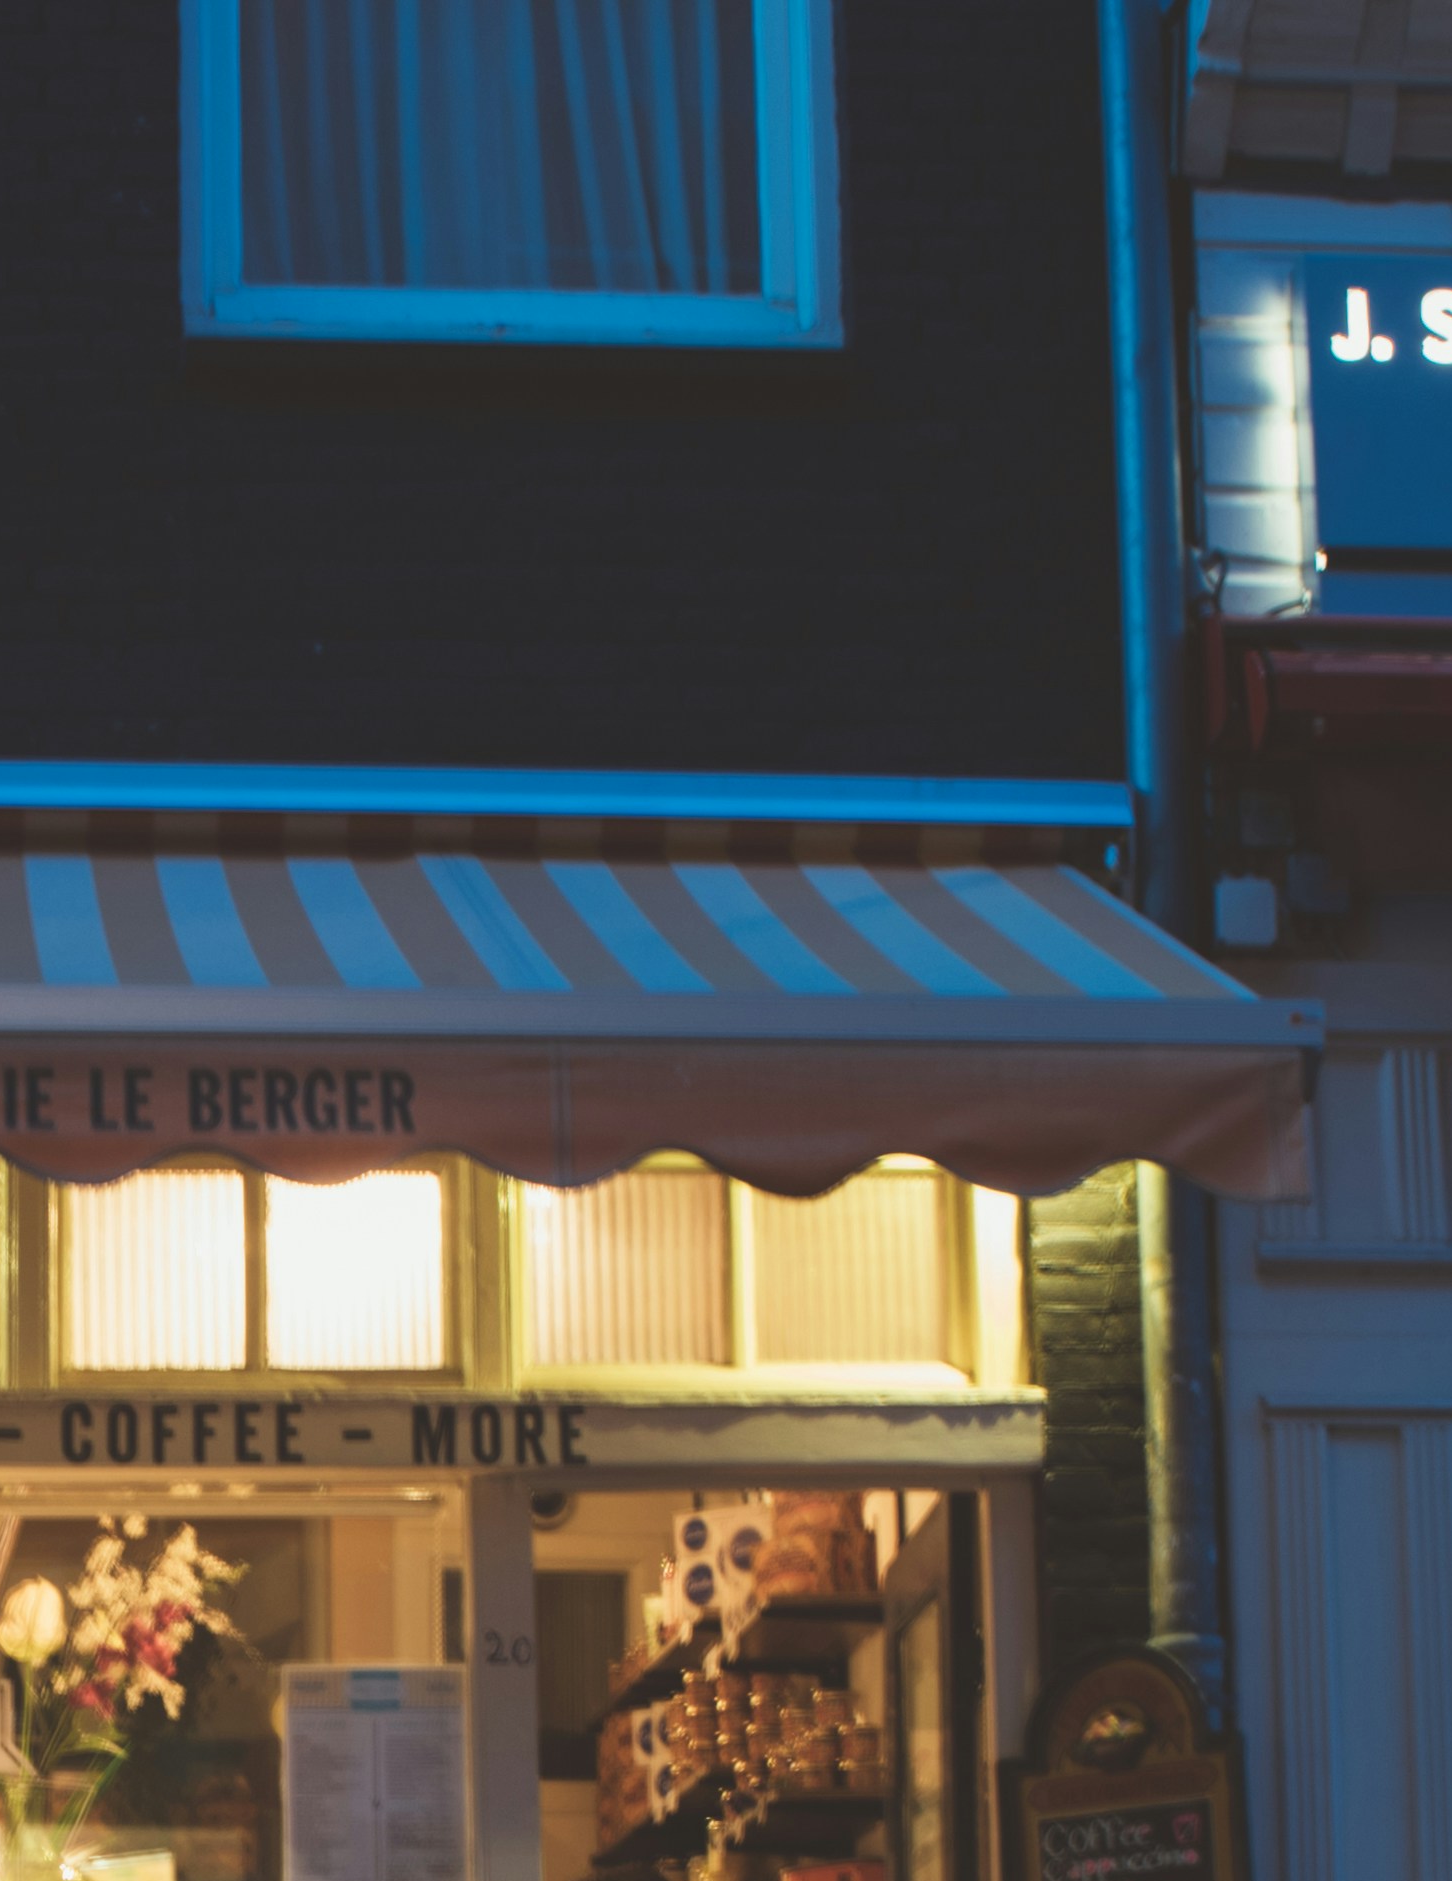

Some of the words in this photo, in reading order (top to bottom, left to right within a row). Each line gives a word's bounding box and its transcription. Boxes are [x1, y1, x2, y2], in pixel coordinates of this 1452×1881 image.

[1331, 286, 1395, 364] J.
[88, 1066, 155, 1132] LE
[187, 1066, 417, 1134] BERGER
[60, 1400, 306, 1467] COFFEE
[410, 1400, 590, 1467] MORE
[483, 1628, 532, 1667] 20
